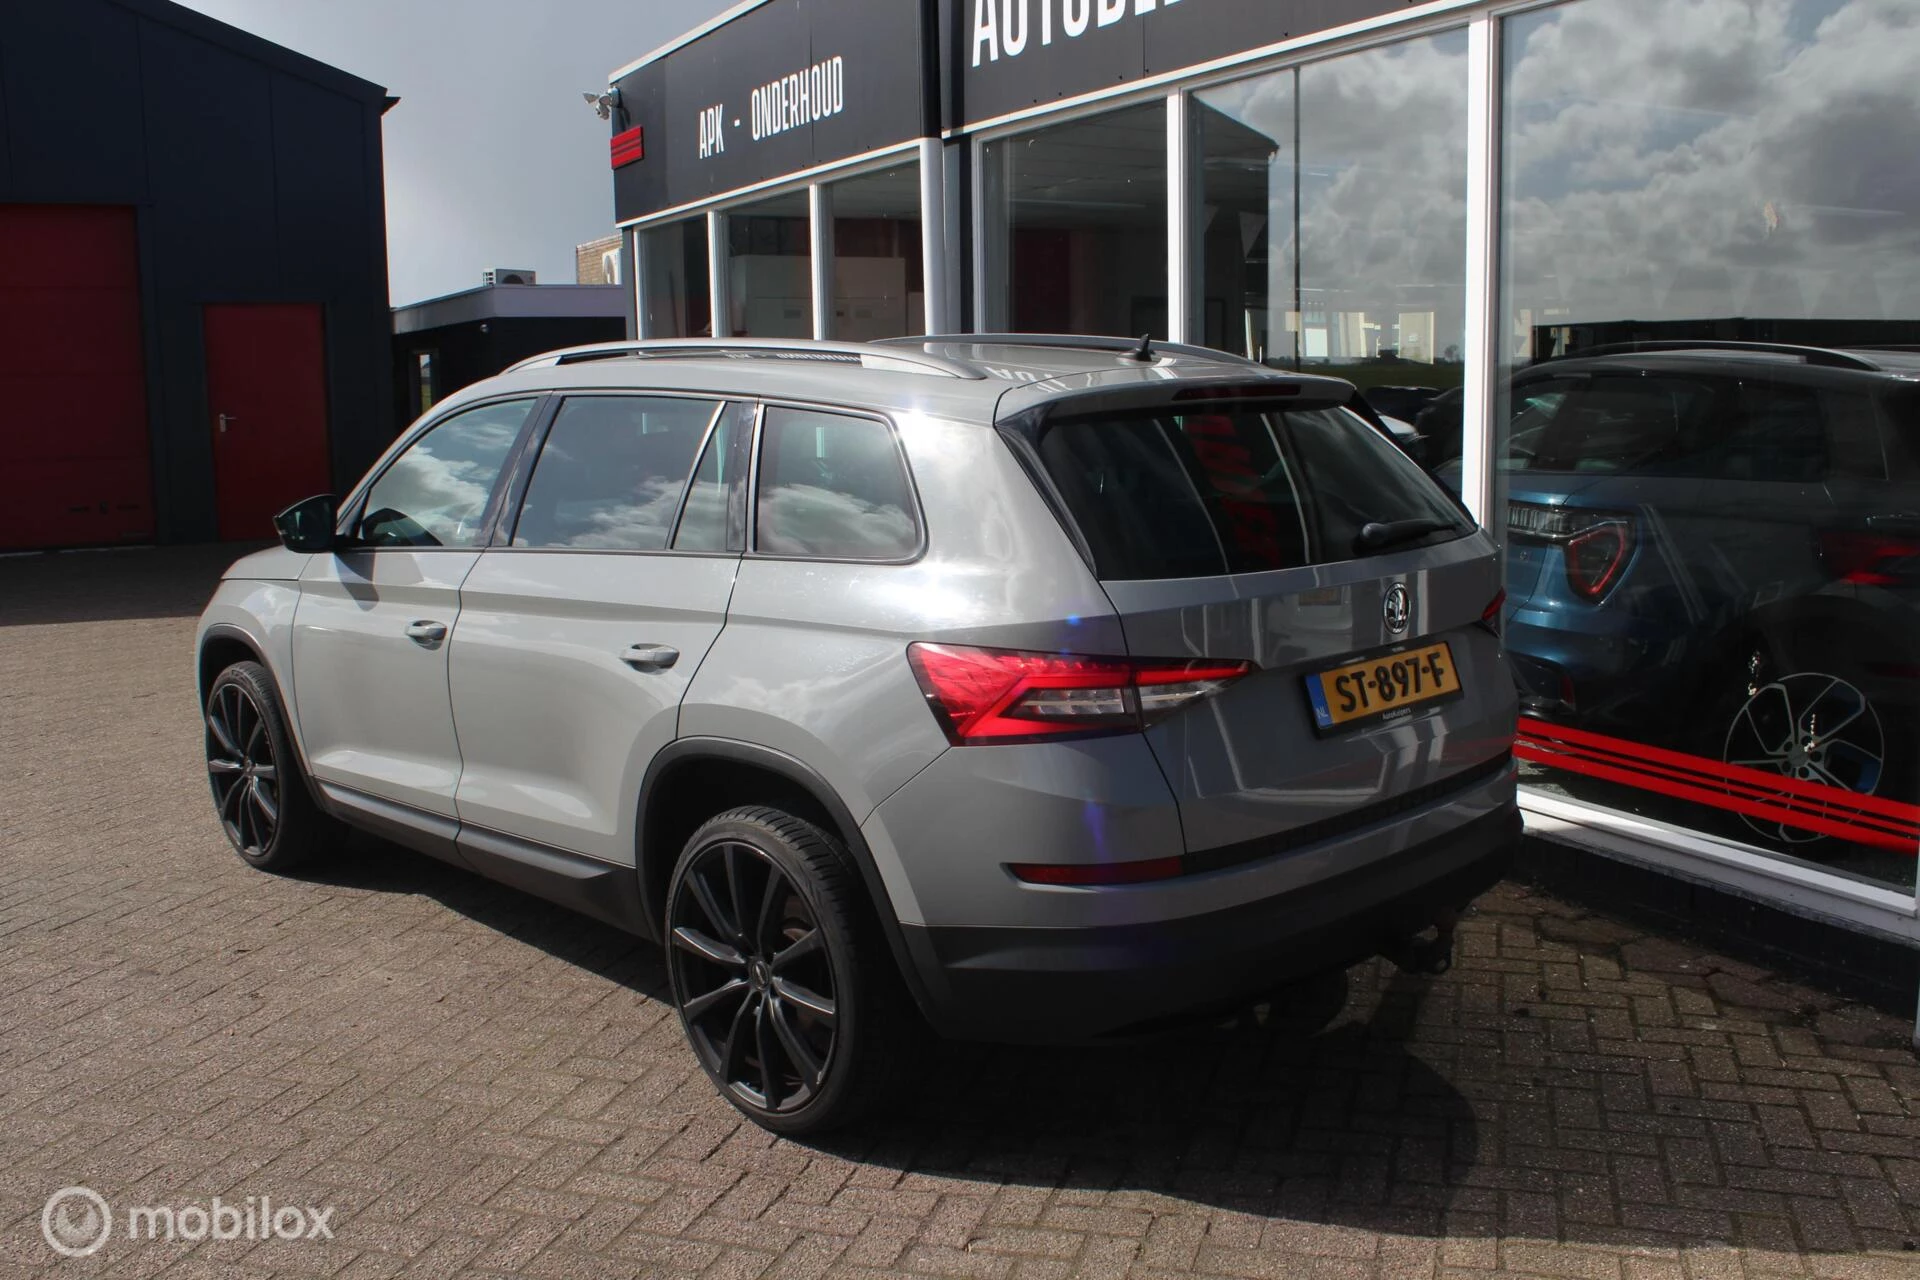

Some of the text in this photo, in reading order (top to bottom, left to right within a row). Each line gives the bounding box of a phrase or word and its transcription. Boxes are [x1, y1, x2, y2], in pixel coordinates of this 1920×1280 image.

[699, 103, 725, 159] APK
[751, 55, 844, 141] ONDERHOUD
[1315, 705, 1329, 719] NL
[1335, 651, 1445, 713] ST-897-F
